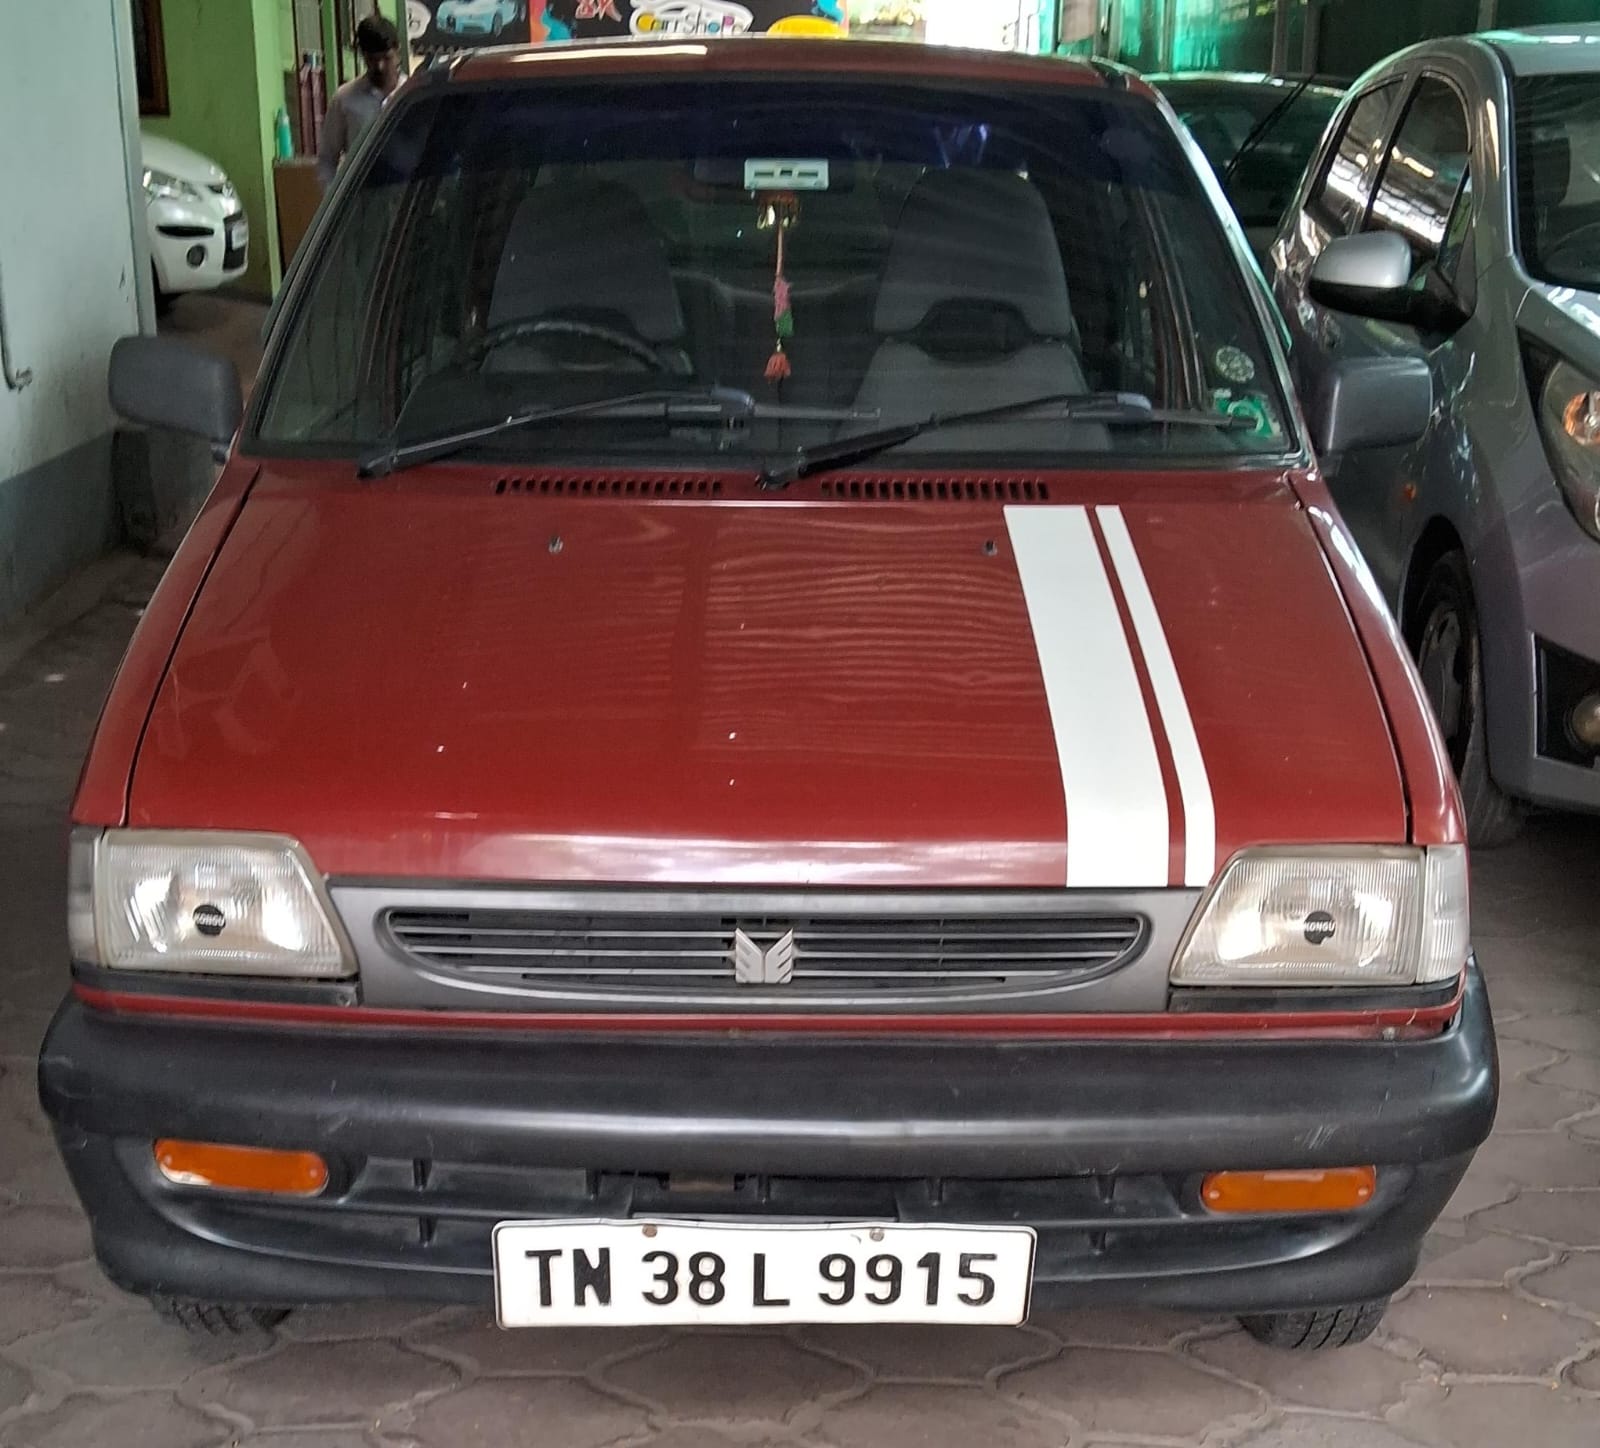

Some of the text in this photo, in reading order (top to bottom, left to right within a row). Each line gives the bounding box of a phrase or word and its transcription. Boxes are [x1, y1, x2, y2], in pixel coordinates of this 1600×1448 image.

[526, 1248, 996, 1306] TN 38 L 9915
